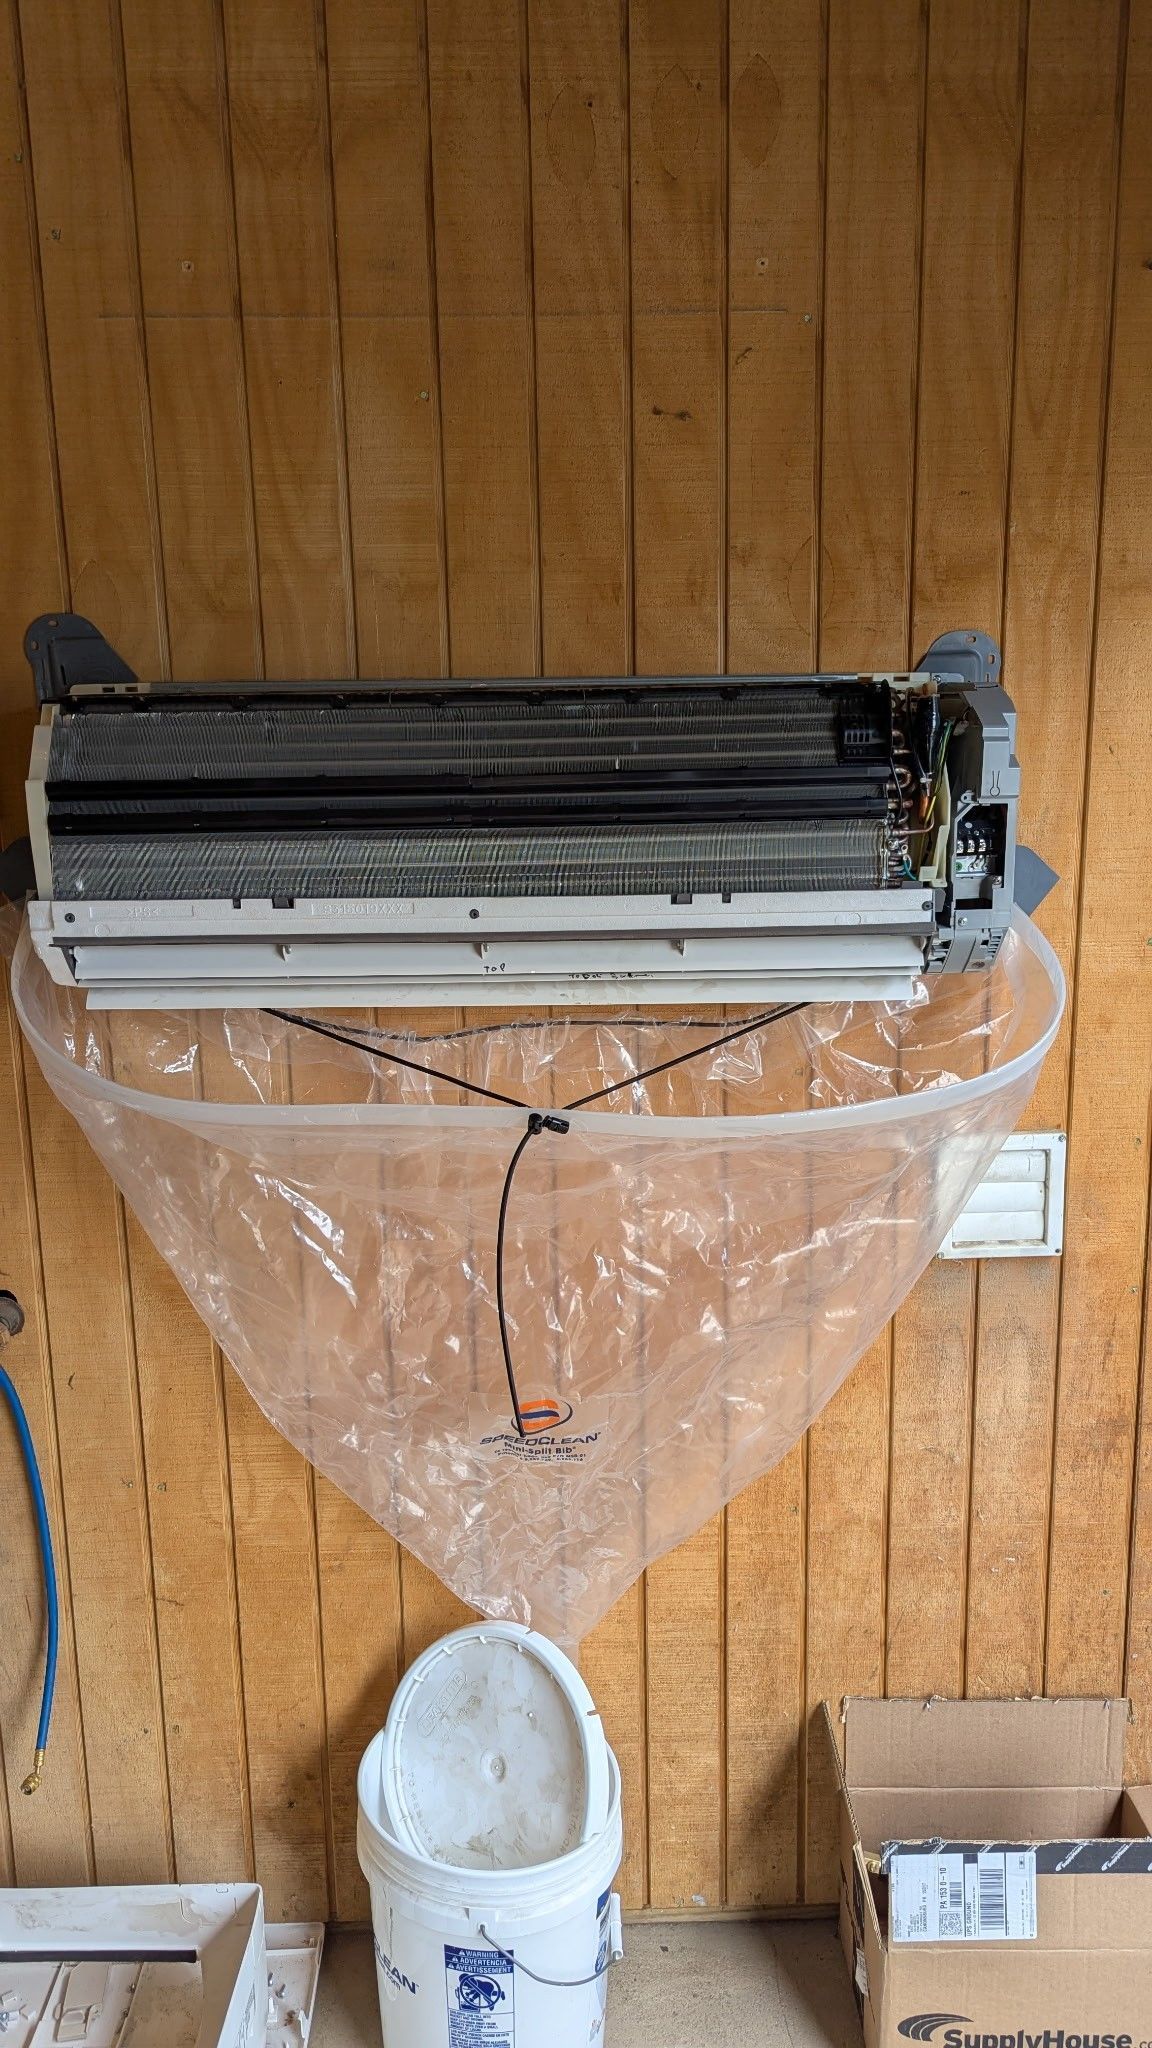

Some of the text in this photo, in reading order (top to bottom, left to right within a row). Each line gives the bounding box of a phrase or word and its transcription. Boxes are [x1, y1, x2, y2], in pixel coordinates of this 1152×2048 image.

[940, 1901, 947, 1909] PA
[465, 1950, 499, 1958] WARNING
[460, 1957, 507, 1966] ADVERTENCIA
[455, 1963, 512, 1973] AVERTISSEMENT
